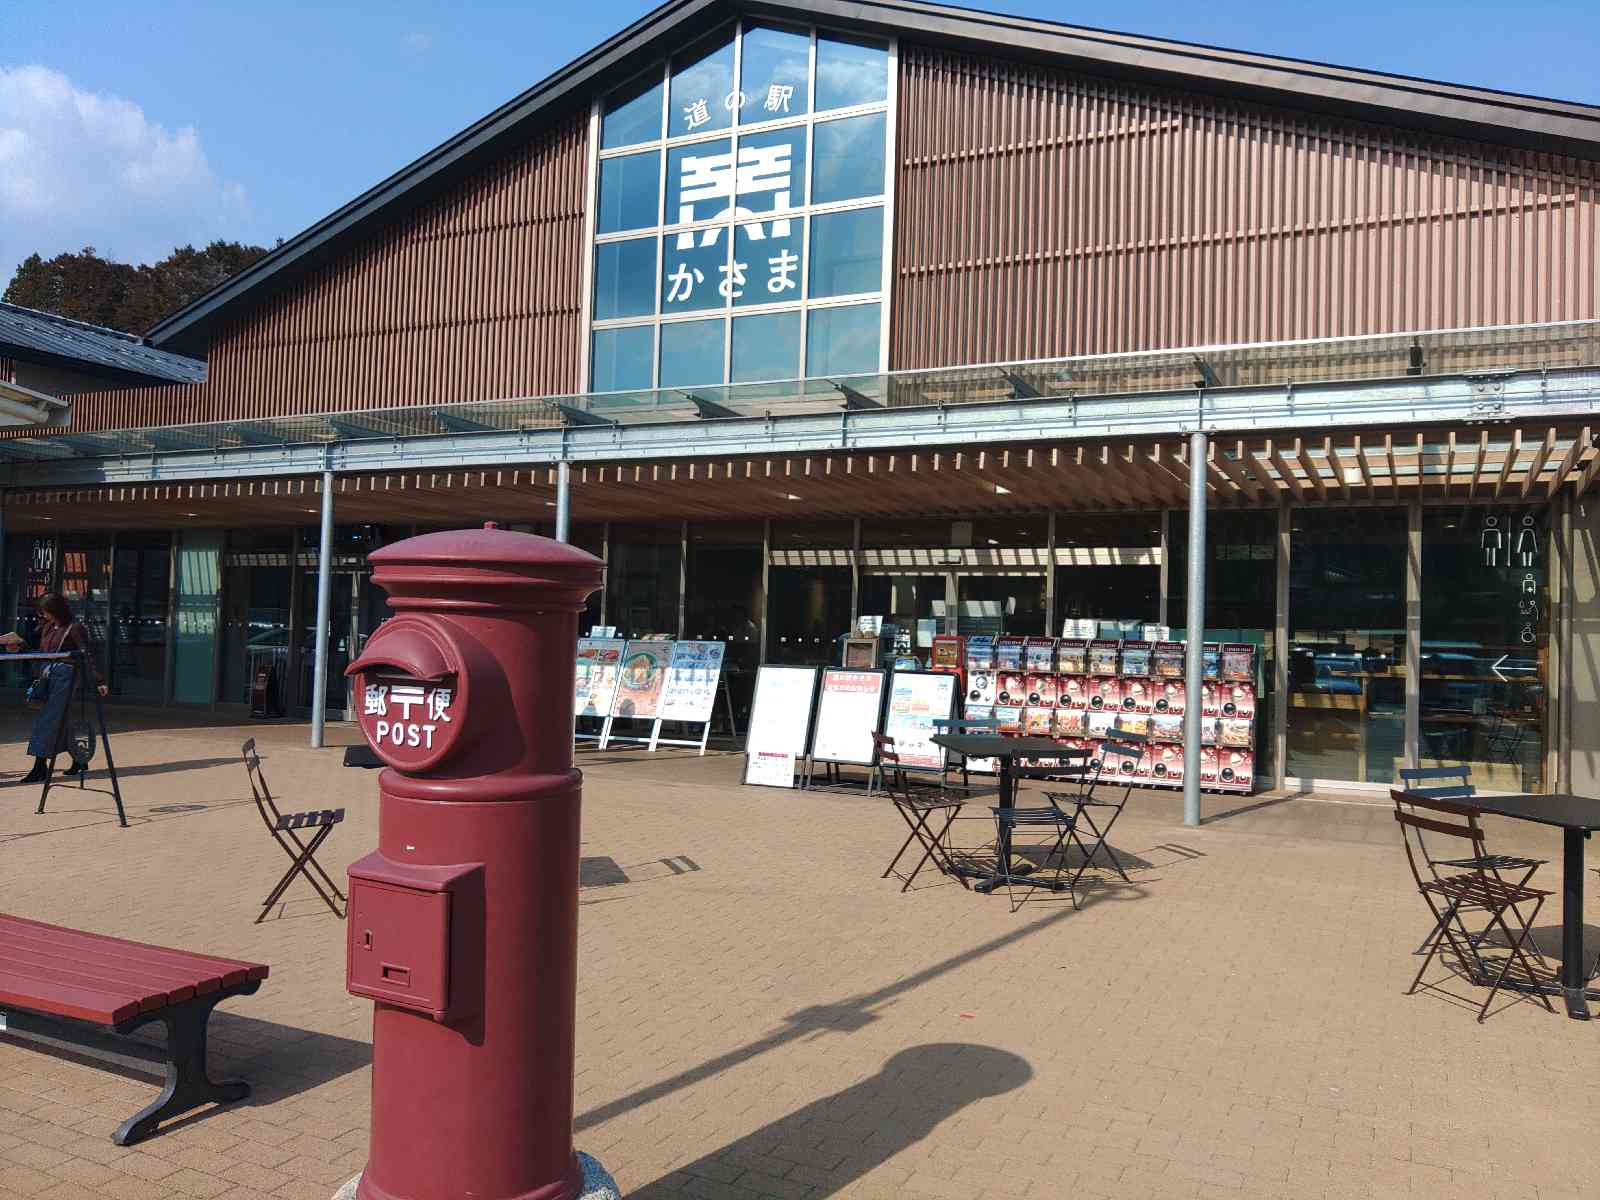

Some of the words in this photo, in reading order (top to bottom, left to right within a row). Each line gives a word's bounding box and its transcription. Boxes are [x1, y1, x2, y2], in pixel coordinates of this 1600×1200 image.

[683, 84, 794, 130] 道の駅
[667, 249, 799, 302] かさま
[376, 721, 436, 749] POST
